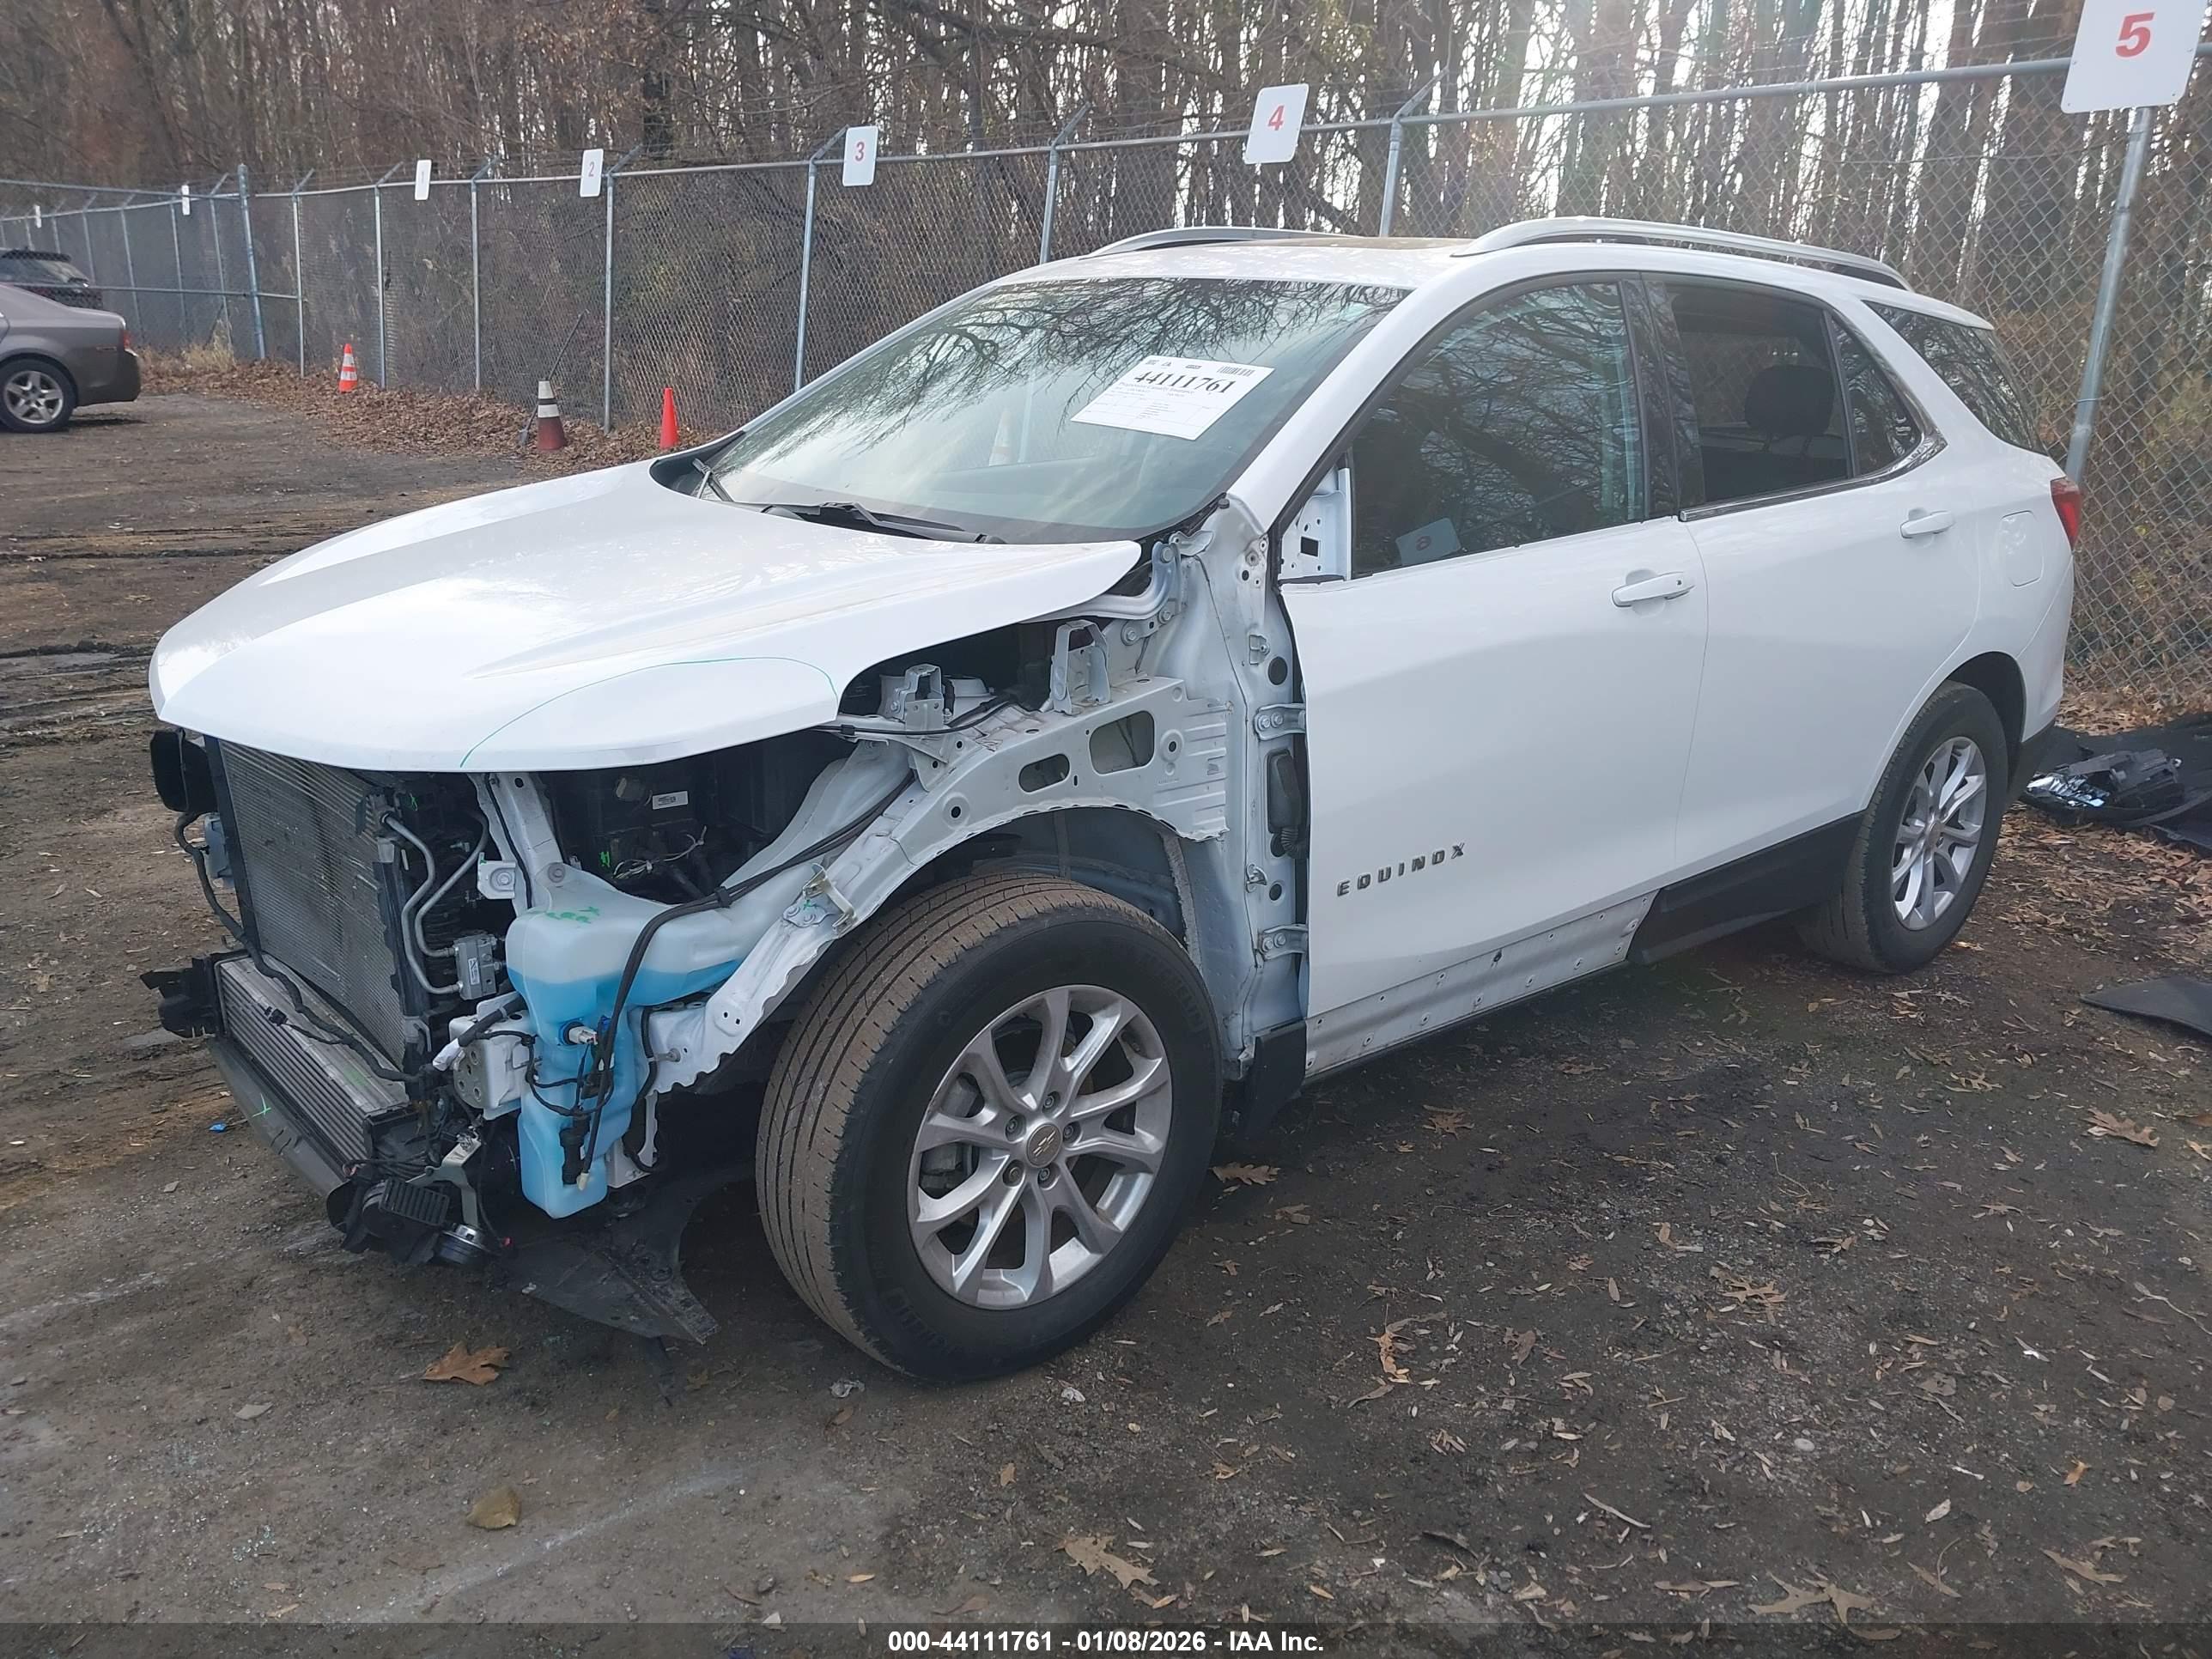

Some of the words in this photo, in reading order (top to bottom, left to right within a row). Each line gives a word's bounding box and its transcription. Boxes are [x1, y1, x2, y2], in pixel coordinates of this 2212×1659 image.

[2115, 12, 2156, 58] 5
[1267, 104, 1285, 131] 4
[854, 140, 866, 163] 3
[587, 160, 595, 178] 2
[1133, 370, 1237, 393] 44111761
[1336, 842, 1466, 896] EQUINOX
